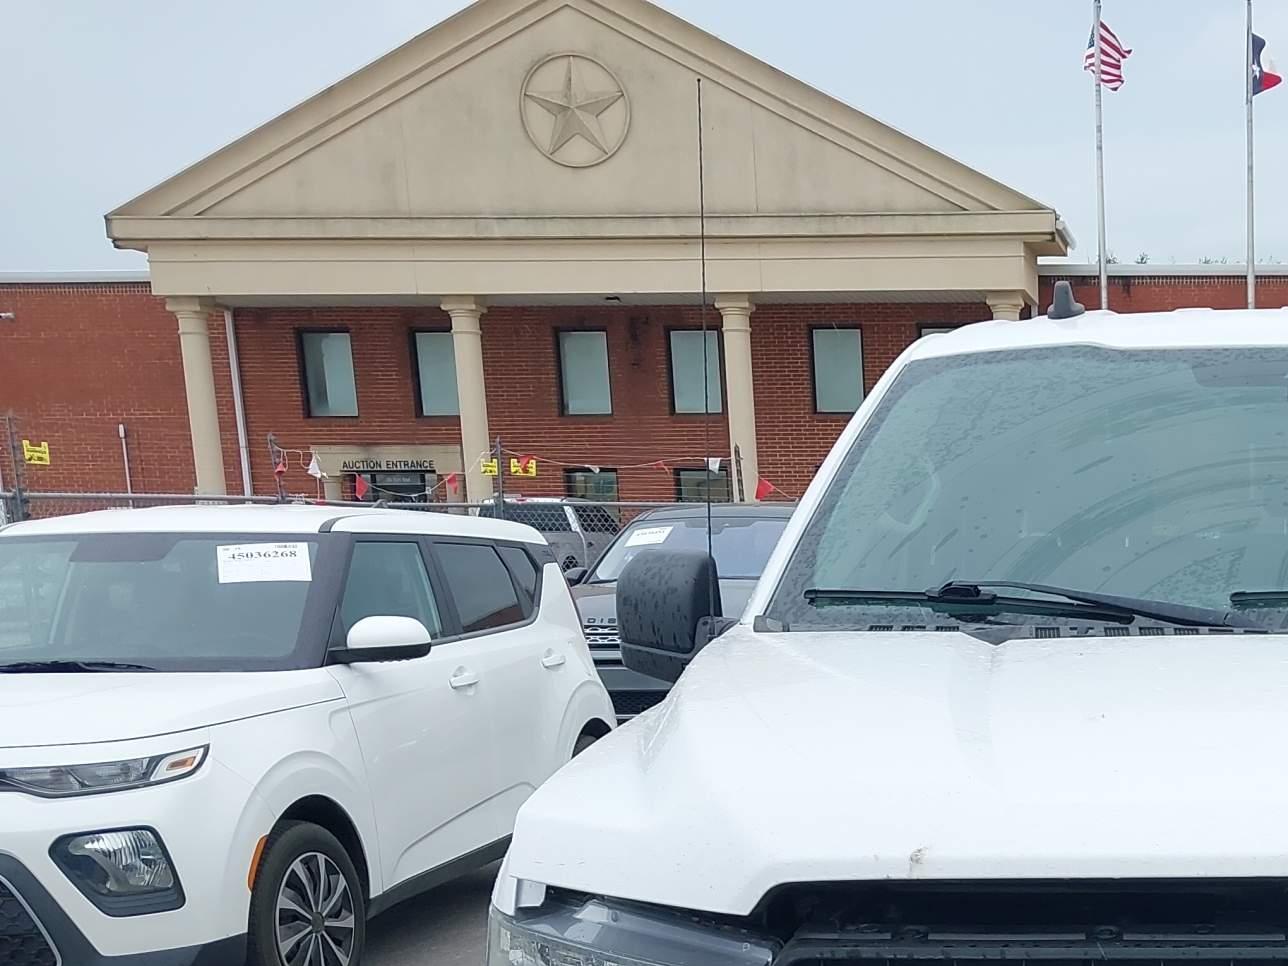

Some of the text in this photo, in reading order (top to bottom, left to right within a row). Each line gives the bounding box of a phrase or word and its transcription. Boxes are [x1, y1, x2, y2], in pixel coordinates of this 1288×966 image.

[342, 460, 435, 469] AUCTION ENTRANCE
[228, 550, 297, 560] 45036268
